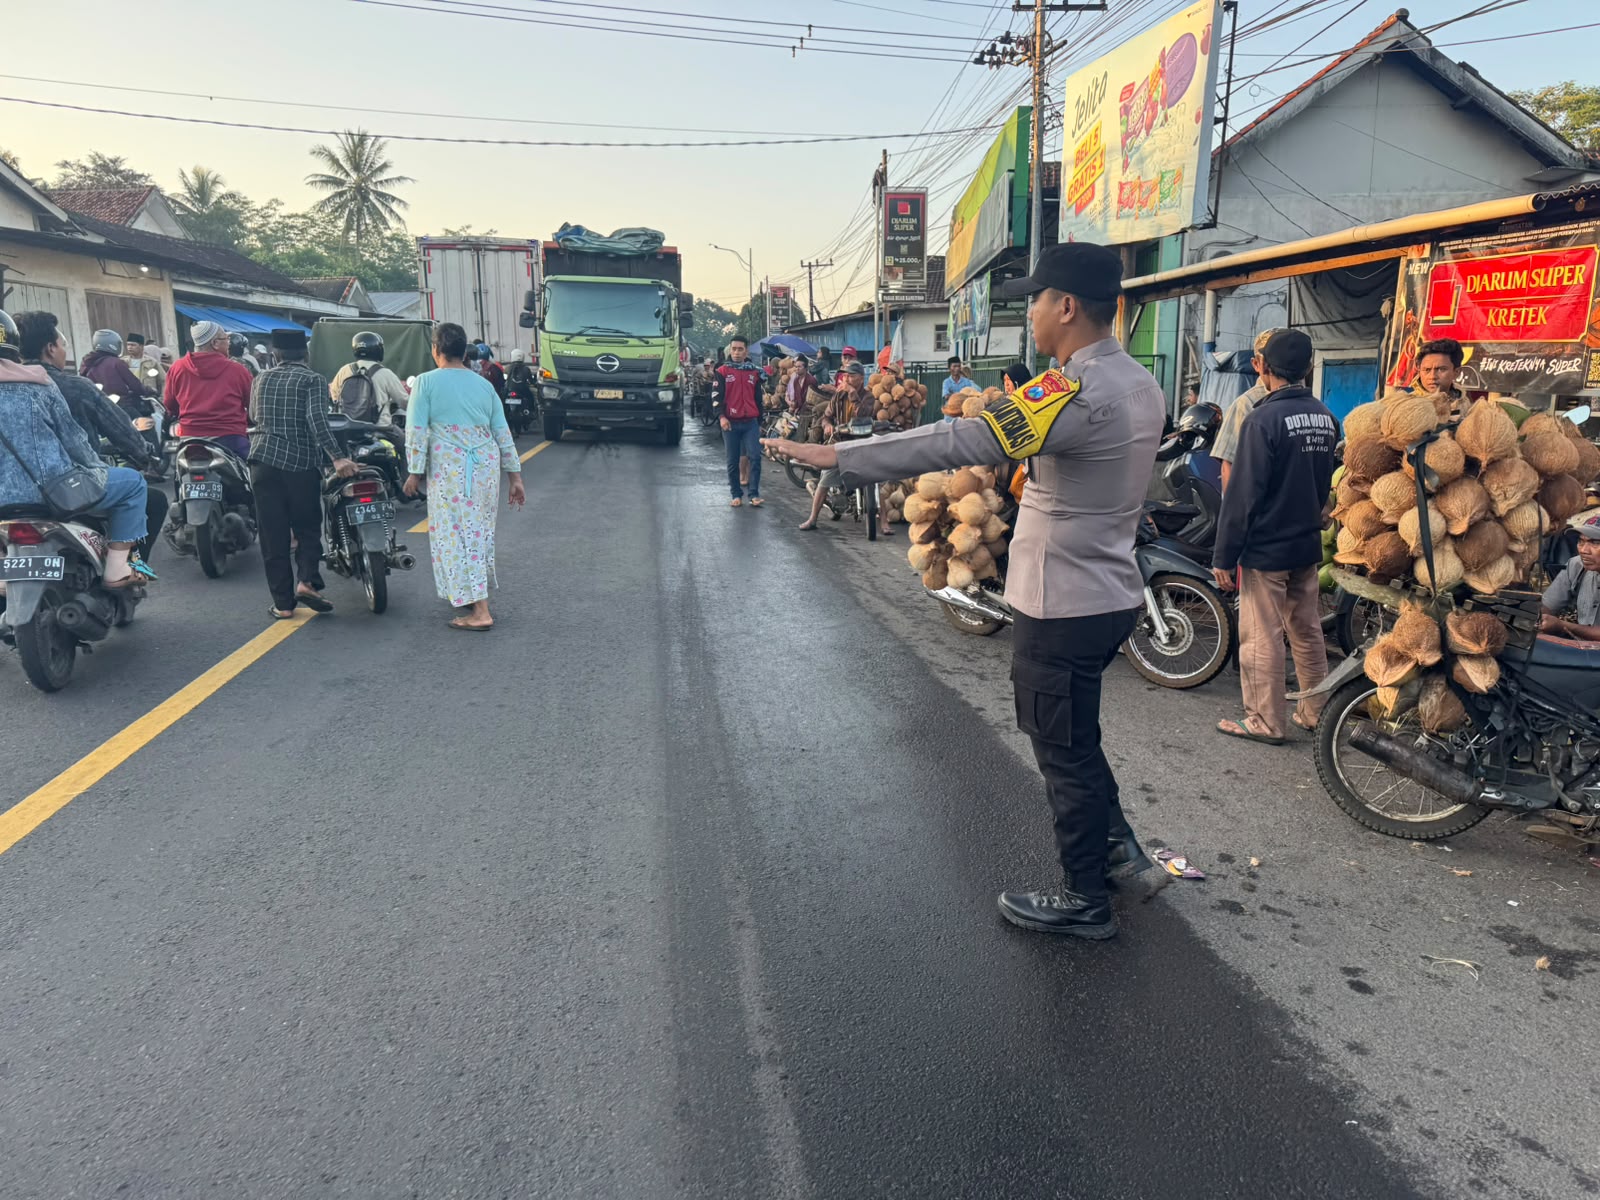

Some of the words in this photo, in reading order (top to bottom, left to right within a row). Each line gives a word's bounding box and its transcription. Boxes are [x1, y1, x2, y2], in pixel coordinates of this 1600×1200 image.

[1072, 71, 1108, 138] Jelita
[1075, 133, 1093, 169] BELI
[1093, 126, 1099, 146] 5
[1067, 157, 1097, 203] GRATIS
[1098, 148, 1104, 170] 1
[1408, 262, 1430, 275] NEW
[1466, 269, 1527, 294] DJARUM
[1529, 264, 1586, 288] SUPER
[1486, 306, 1550, 327] KRETEK
[1497, 356, 1546, 374] KRETEKNYA
[1545, 358, 1582, 375] SUPER
[1284, 413, 1310, 430] DUTA
[3, 558, 32, 569] 5221
